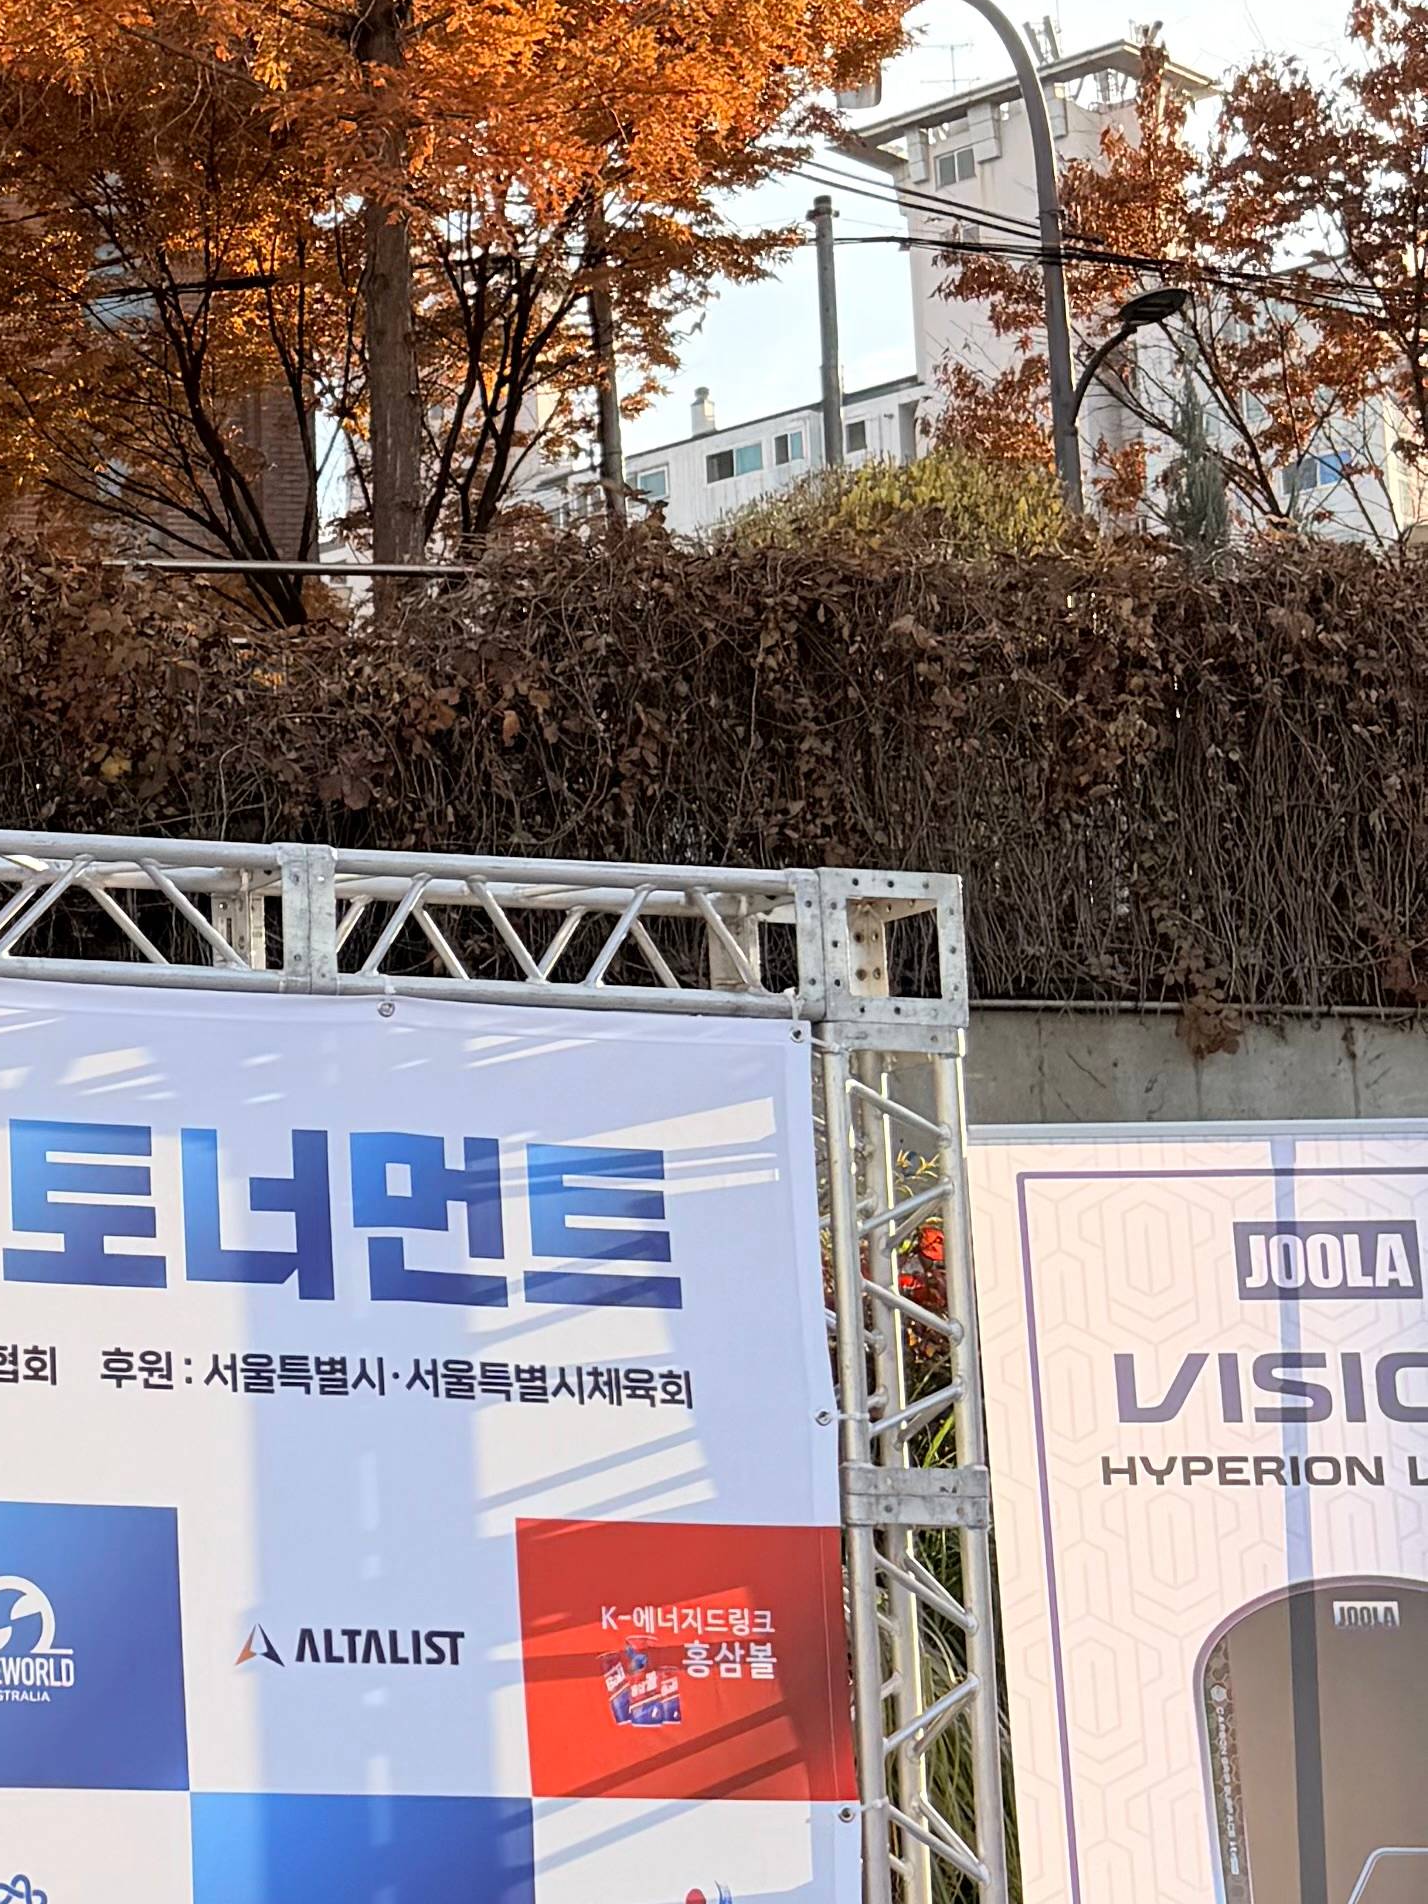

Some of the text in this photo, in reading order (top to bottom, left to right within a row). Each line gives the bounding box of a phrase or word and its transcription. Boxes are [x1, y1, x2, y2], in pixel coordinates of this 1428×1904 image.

[2, 1118, 684, 1310] 토너먼트
[1245, 1232, 1415, 1290] JOOLA
[99, 1346, 174, 1390] 후원
[1101, 1455, 1385, 1486] HYPERION
[600, 1605, 776, 1638] K-에너지드링크
[295, 1628, 465, 1666] ALTALIST
[681, 1639, 778, 1680] 홍삼볼
